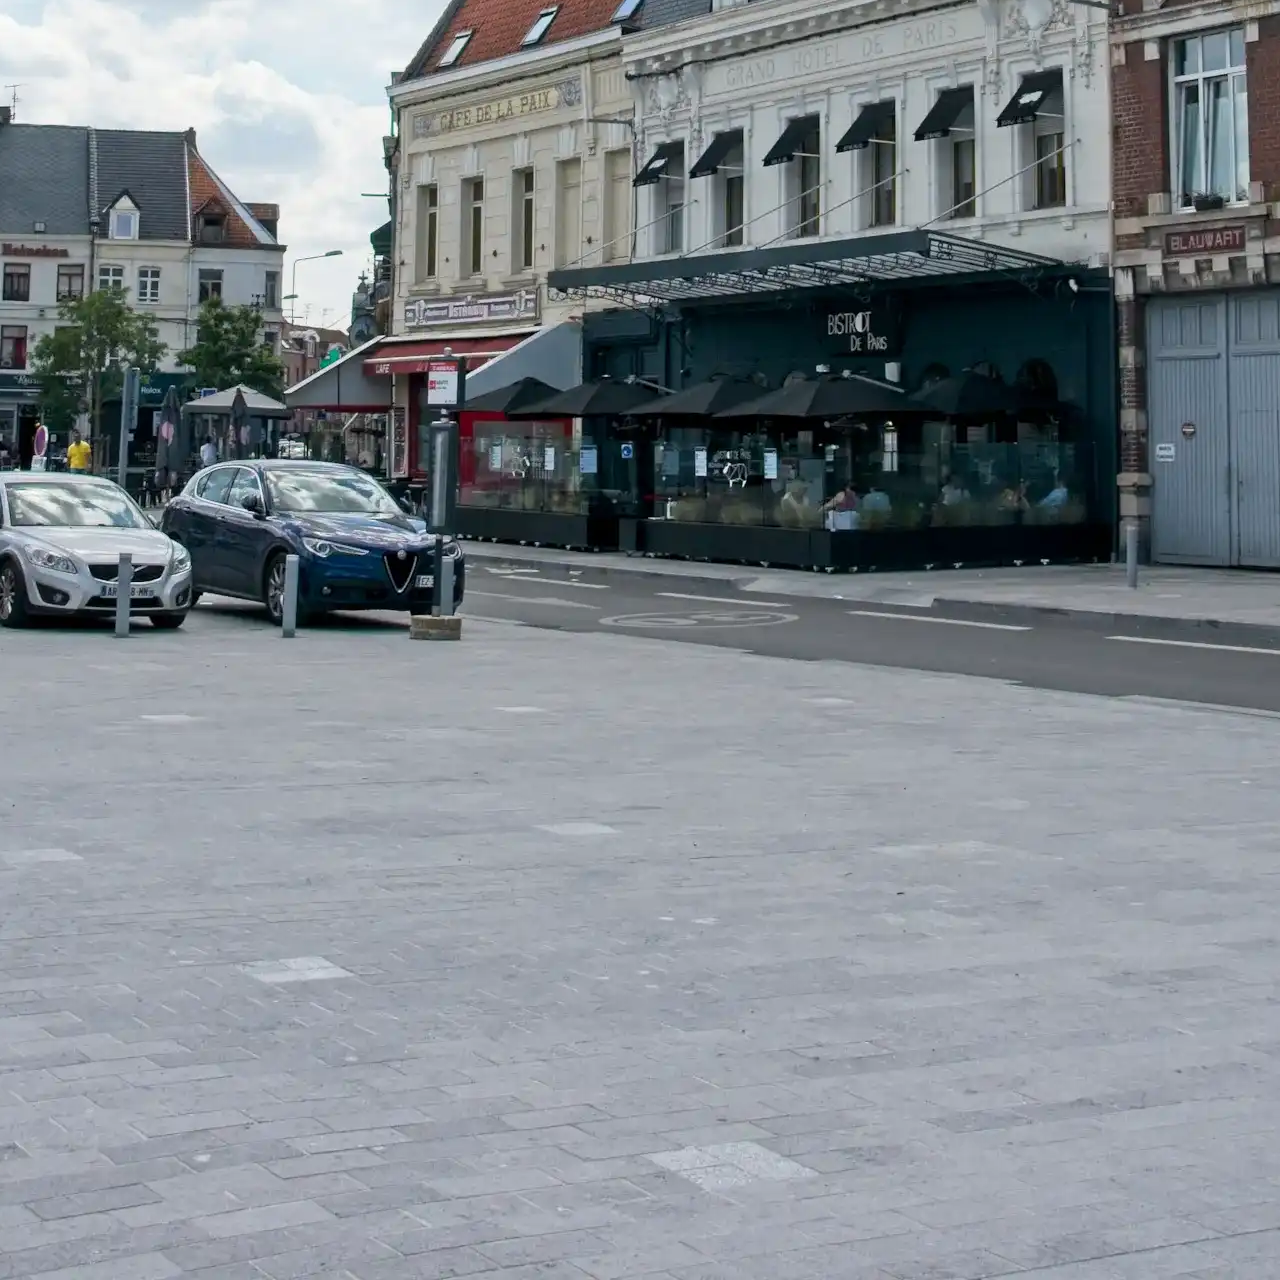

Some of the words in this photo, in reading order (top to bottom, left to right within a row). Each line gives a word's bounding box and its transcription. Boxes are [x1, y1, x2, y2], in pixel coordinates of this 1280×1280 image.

[726, 59, 775, 86] GRAND
[862, 33, 884, 57] DE
[903, 19, 957, 48] PARIS
[476, 105, 492, 123] DE
[496, 99, 514, 119] LA
[520, 90, 551, 113] PAIX
[2, 243, 69, 257] Heineken
[828, 311, 872, 335] BISTROT
[851, 335, 862, 351] DE
[868, 332, 888, 350] PARIS
